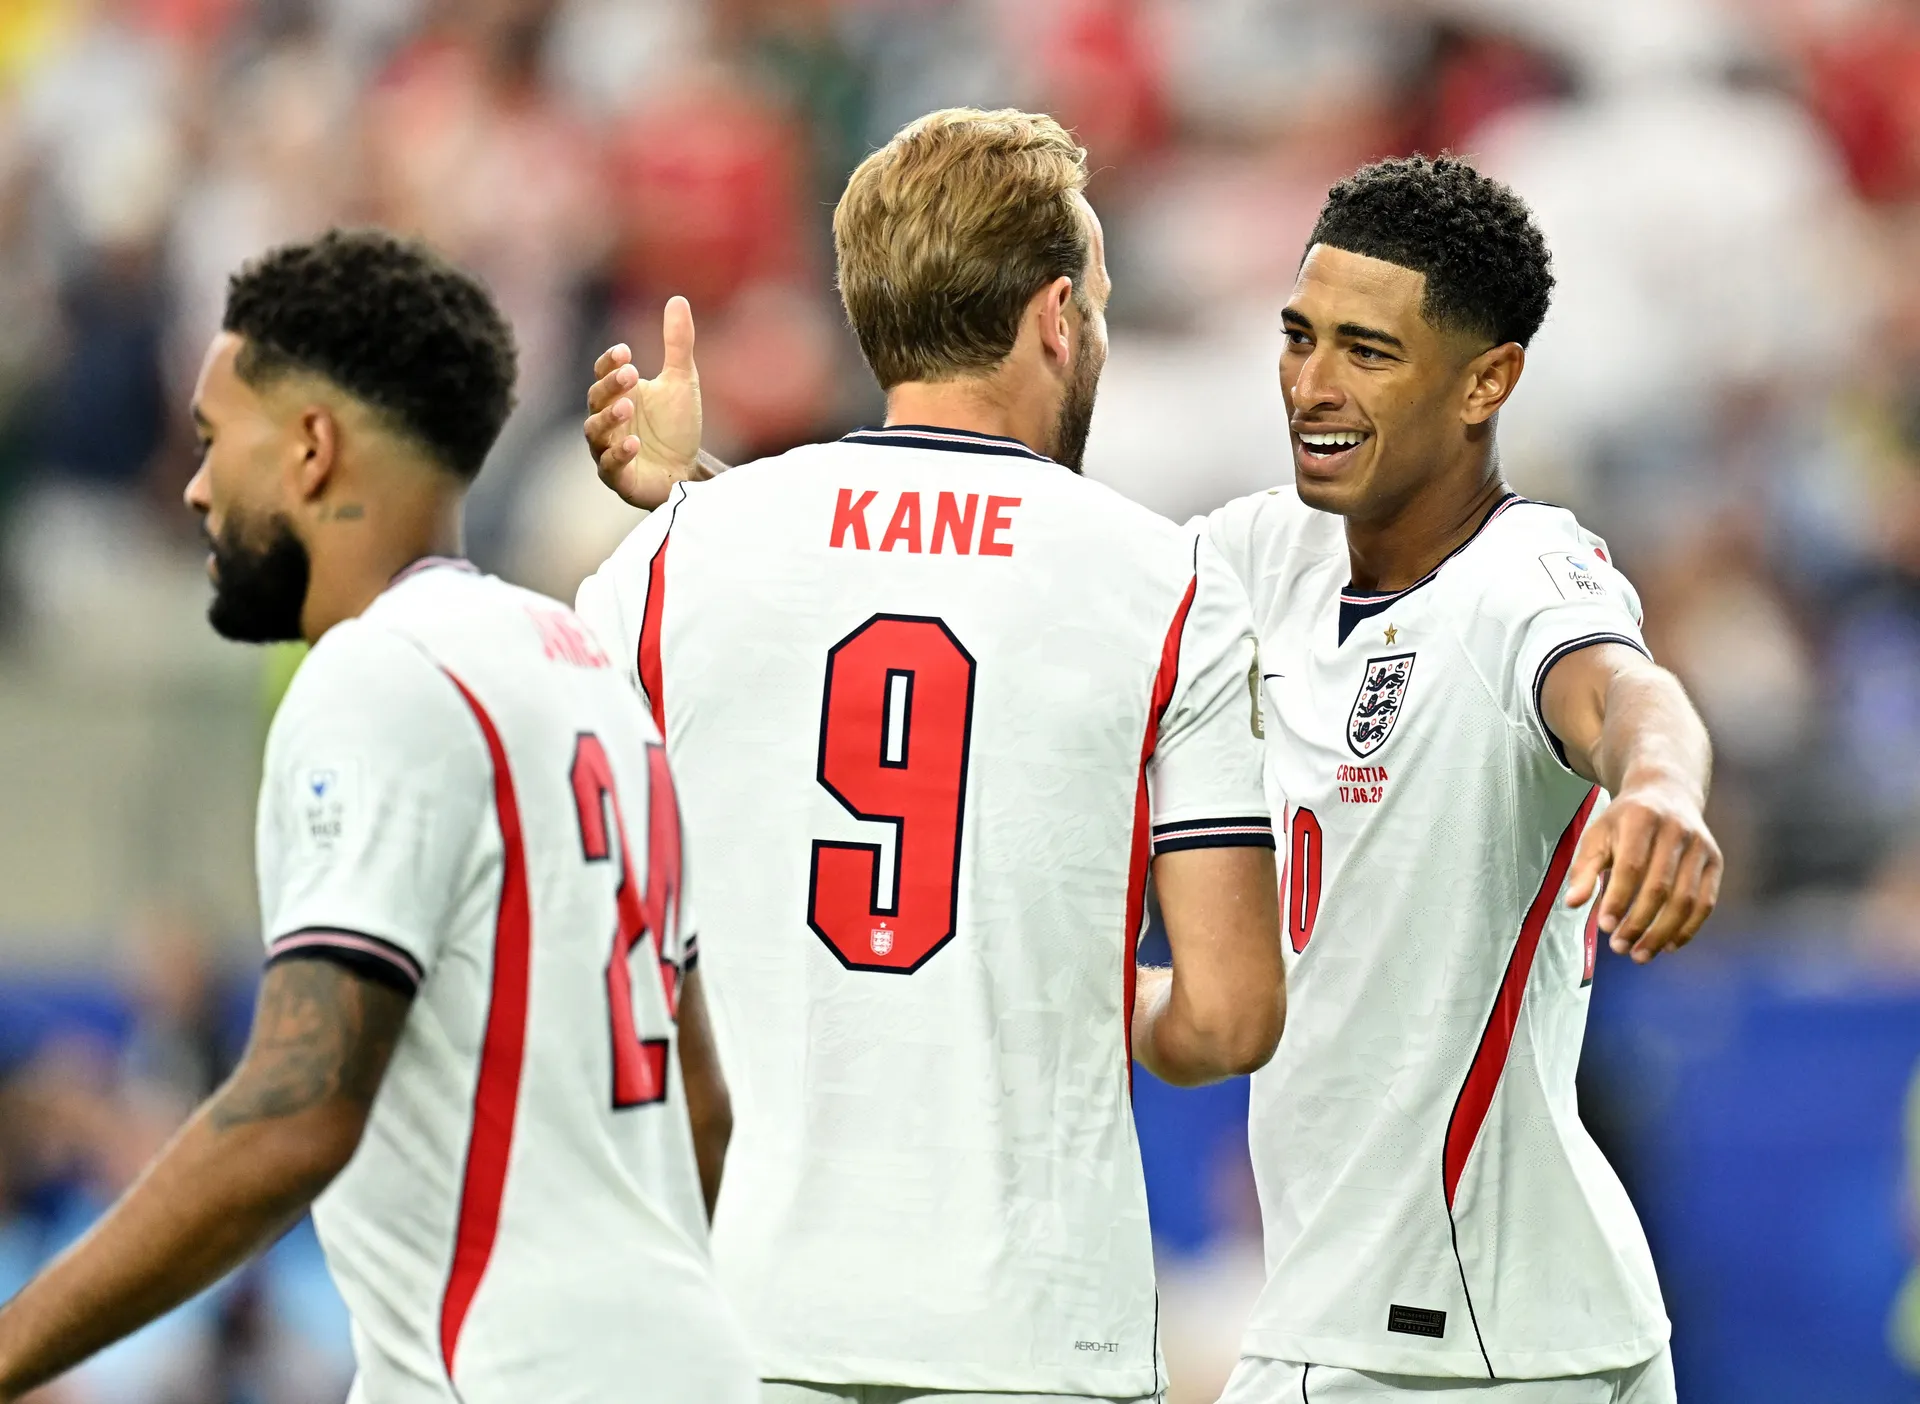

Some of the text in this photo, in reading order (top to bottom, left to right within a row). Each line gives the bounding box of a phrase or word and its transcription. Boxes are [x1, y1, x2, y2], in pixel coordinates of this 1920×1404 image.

[829, 488, 1022, 558] KANE
[806, 612, 977, 976] 9
[1336, 764, 1388, 782] CROATIA
[1280, 800, 1323, 955] 0
